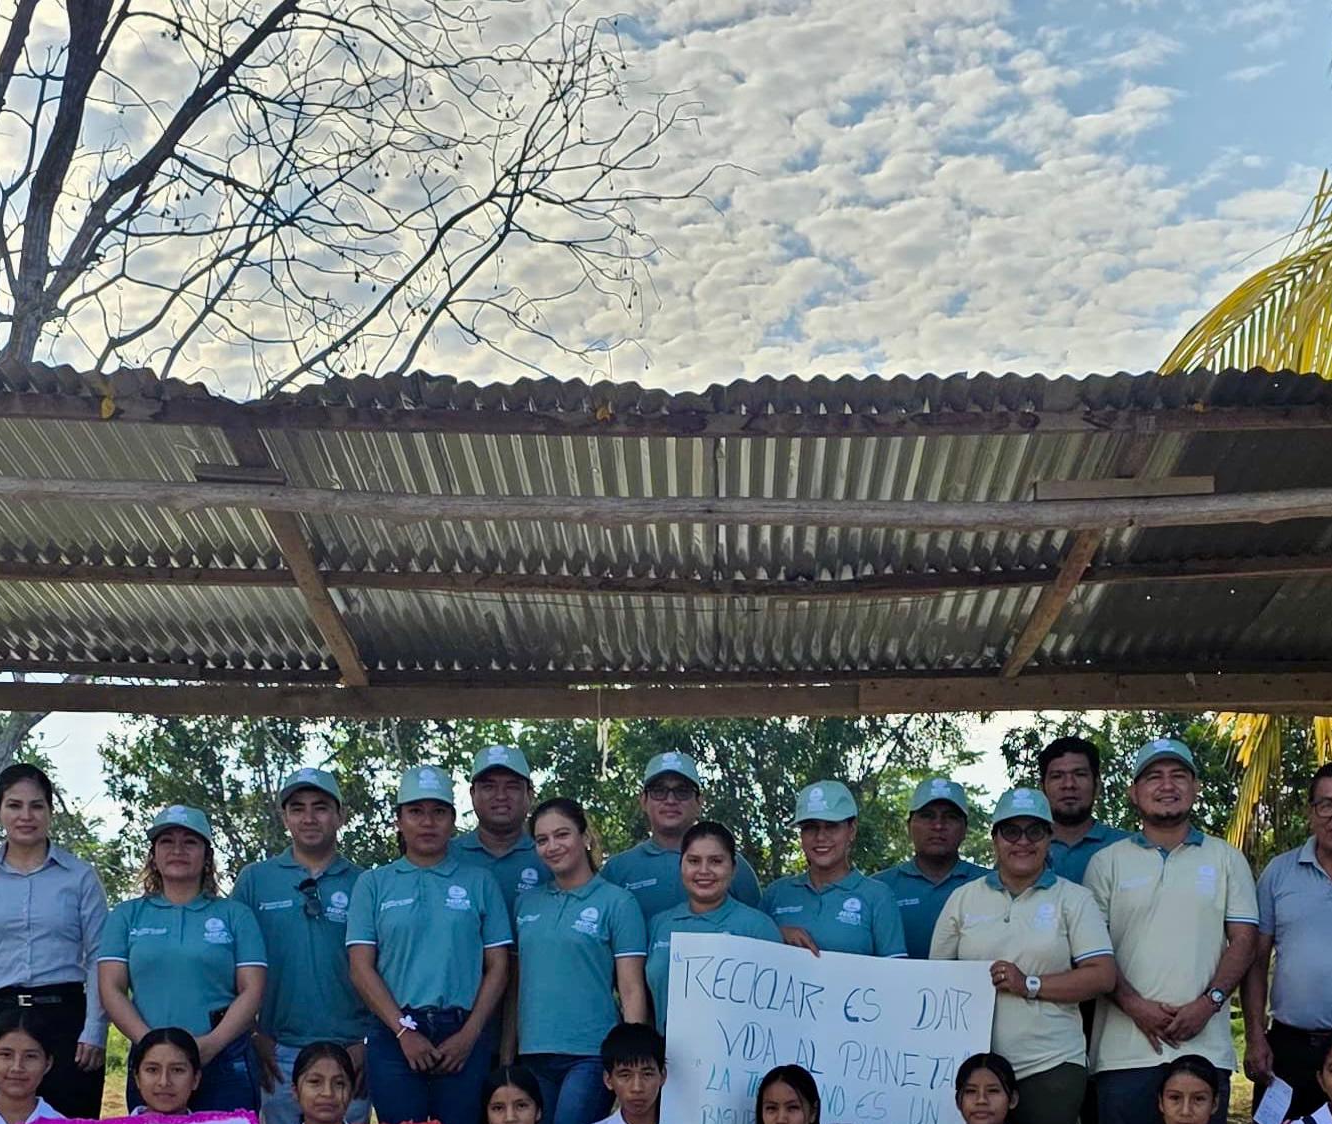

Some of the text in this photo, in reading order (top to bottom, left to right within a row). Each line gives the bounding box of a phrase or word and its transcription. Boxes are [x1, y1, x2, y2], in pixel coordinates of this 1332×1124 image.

[844, 988, 881, 1022] ES
[910, 987, 972, 1031] DAR
[717, 1020, 778, 1066] VIDA
[795, 1038, 824, 1075] AL
